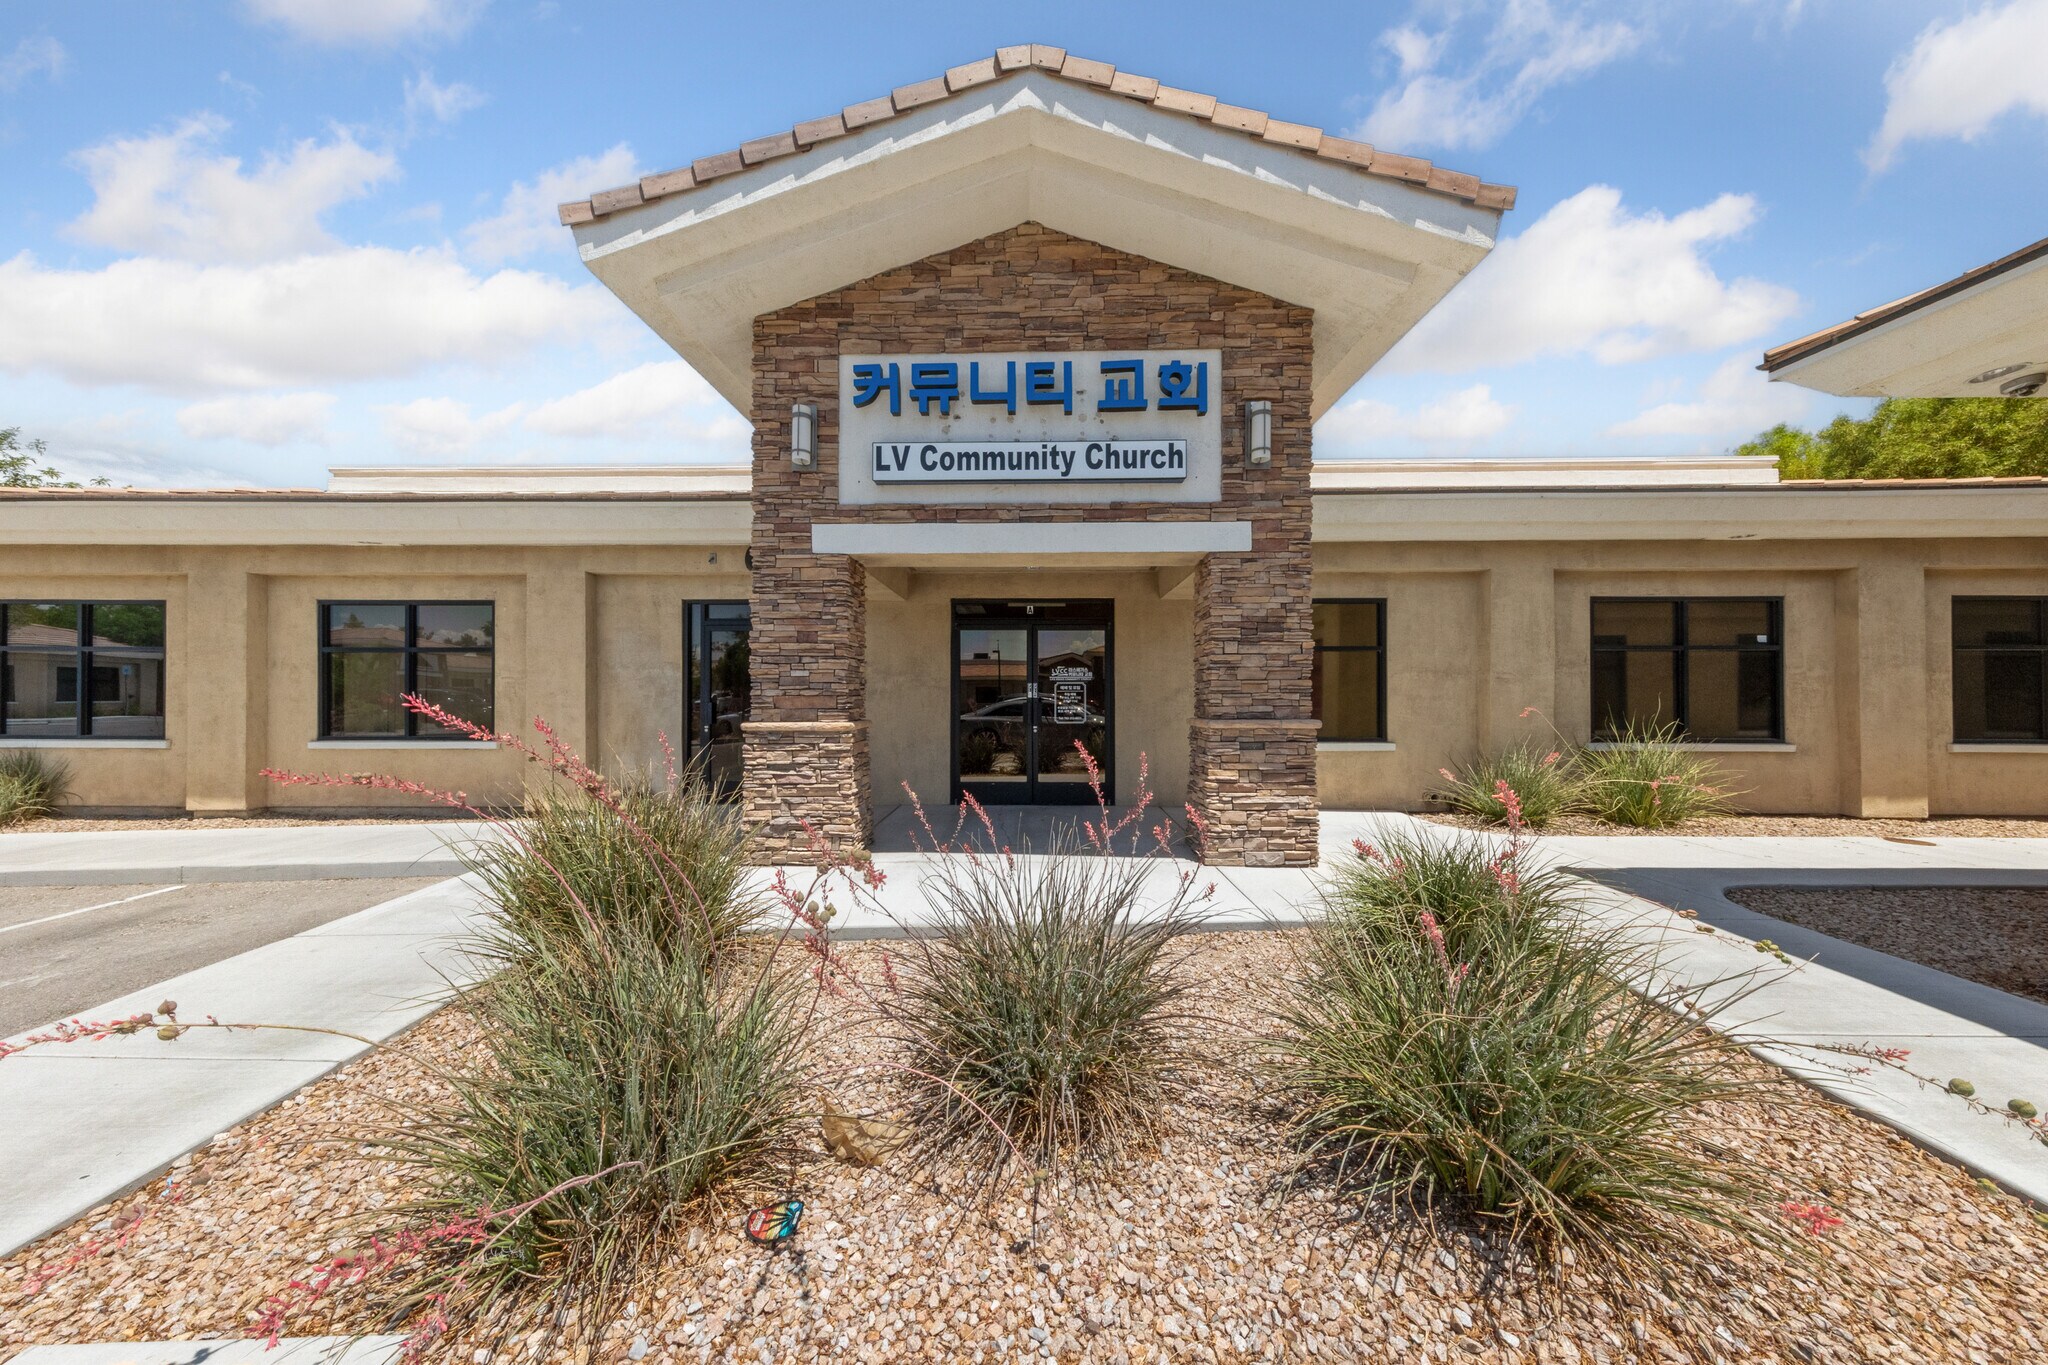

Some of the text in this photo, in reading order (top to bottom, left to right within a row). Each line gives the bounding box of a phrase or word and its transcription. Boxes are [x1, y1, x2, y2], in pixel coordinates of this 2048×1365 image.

[853, 359, 1208, 416] 커뮤니티 교회
[875, 442, 1184, 477] LV Community Church
[1027, 605, 1034, 614] A
